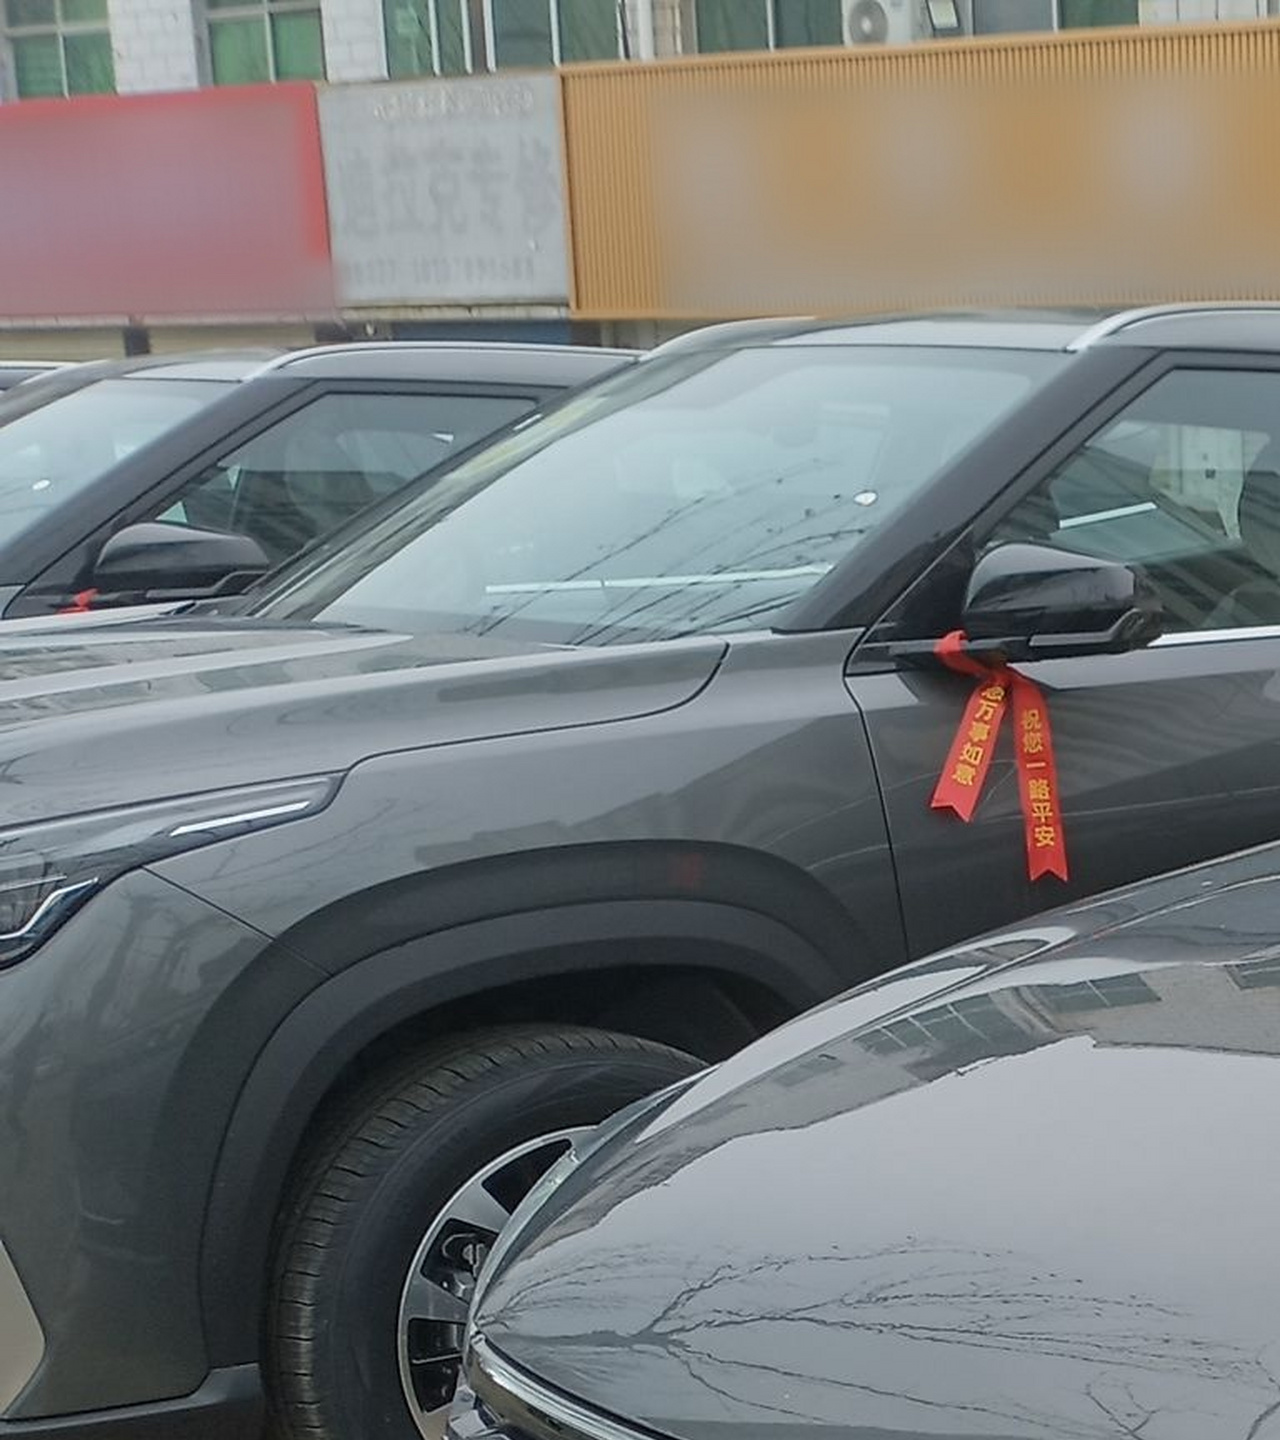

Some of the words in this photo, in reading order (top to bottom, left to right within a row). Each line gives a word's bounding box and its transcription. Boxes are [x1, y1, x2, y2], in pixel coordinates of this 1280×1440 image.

[1022, 708, 1056, 848] 祝您一路平安
